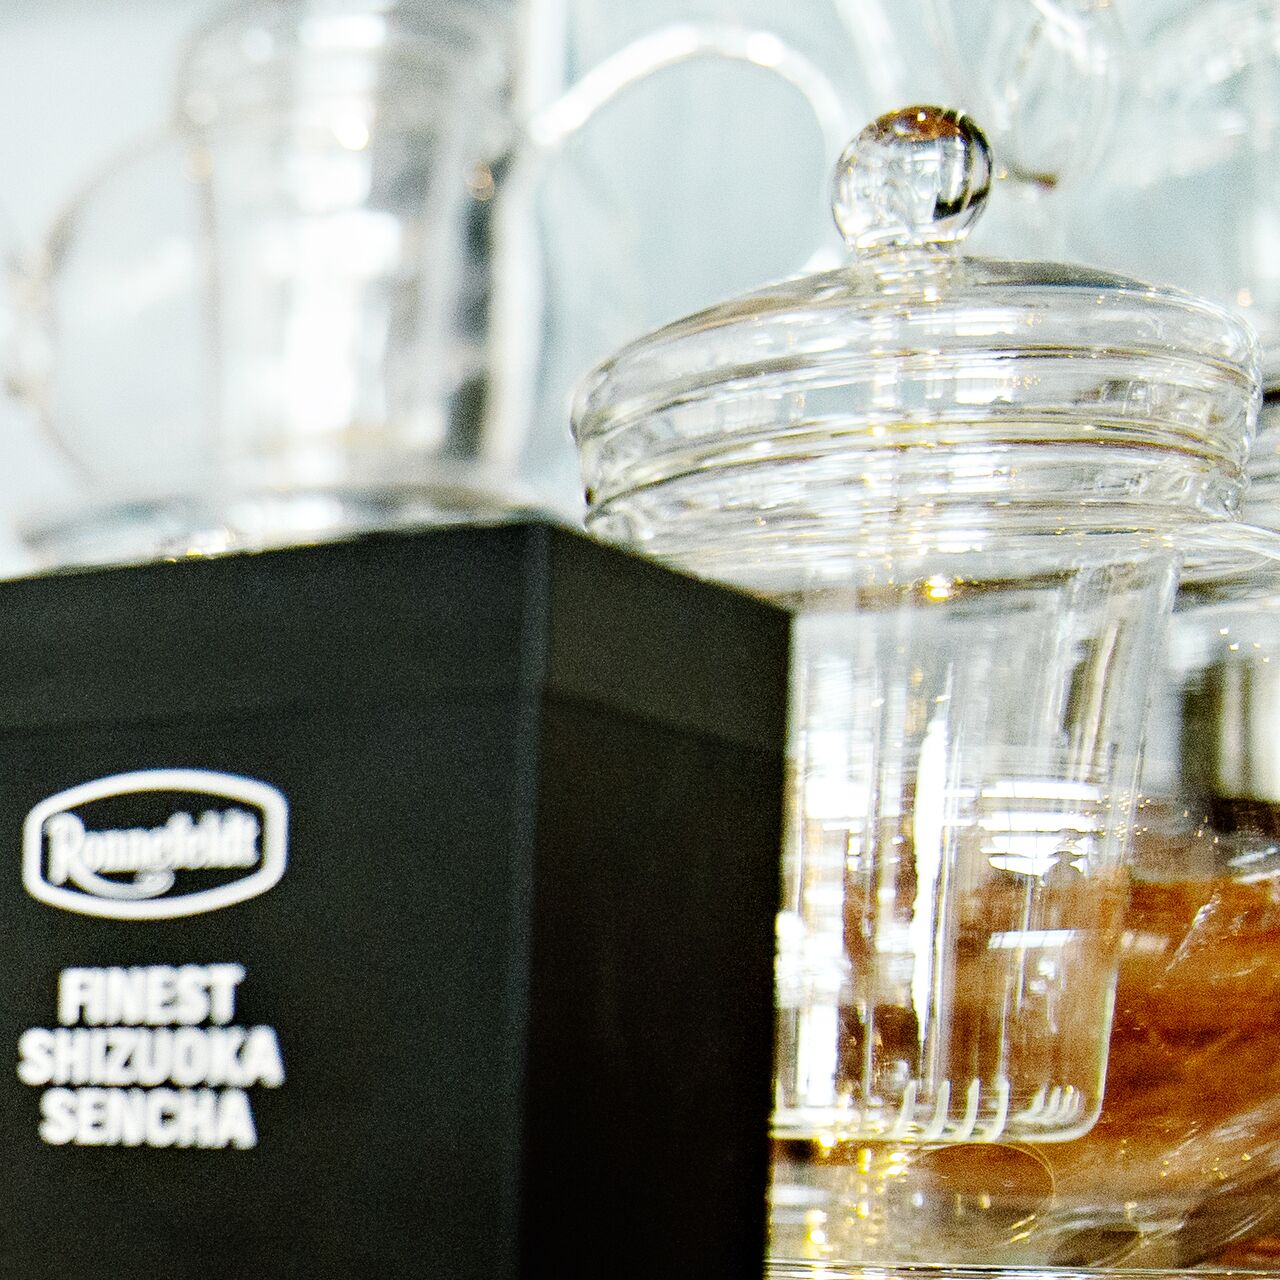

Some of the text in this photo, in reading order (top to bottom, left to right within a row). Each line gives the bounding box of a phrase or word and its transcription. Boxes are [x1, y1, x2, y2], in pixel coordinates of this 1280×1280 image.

[42, 807, 262, 901] Ronnefeldt
[58, 962, 247, 1027] FINEST
[17, 1025, 286, 1088] SHIZUOKA
[38, 1087, 258, 1150] SENCHA
